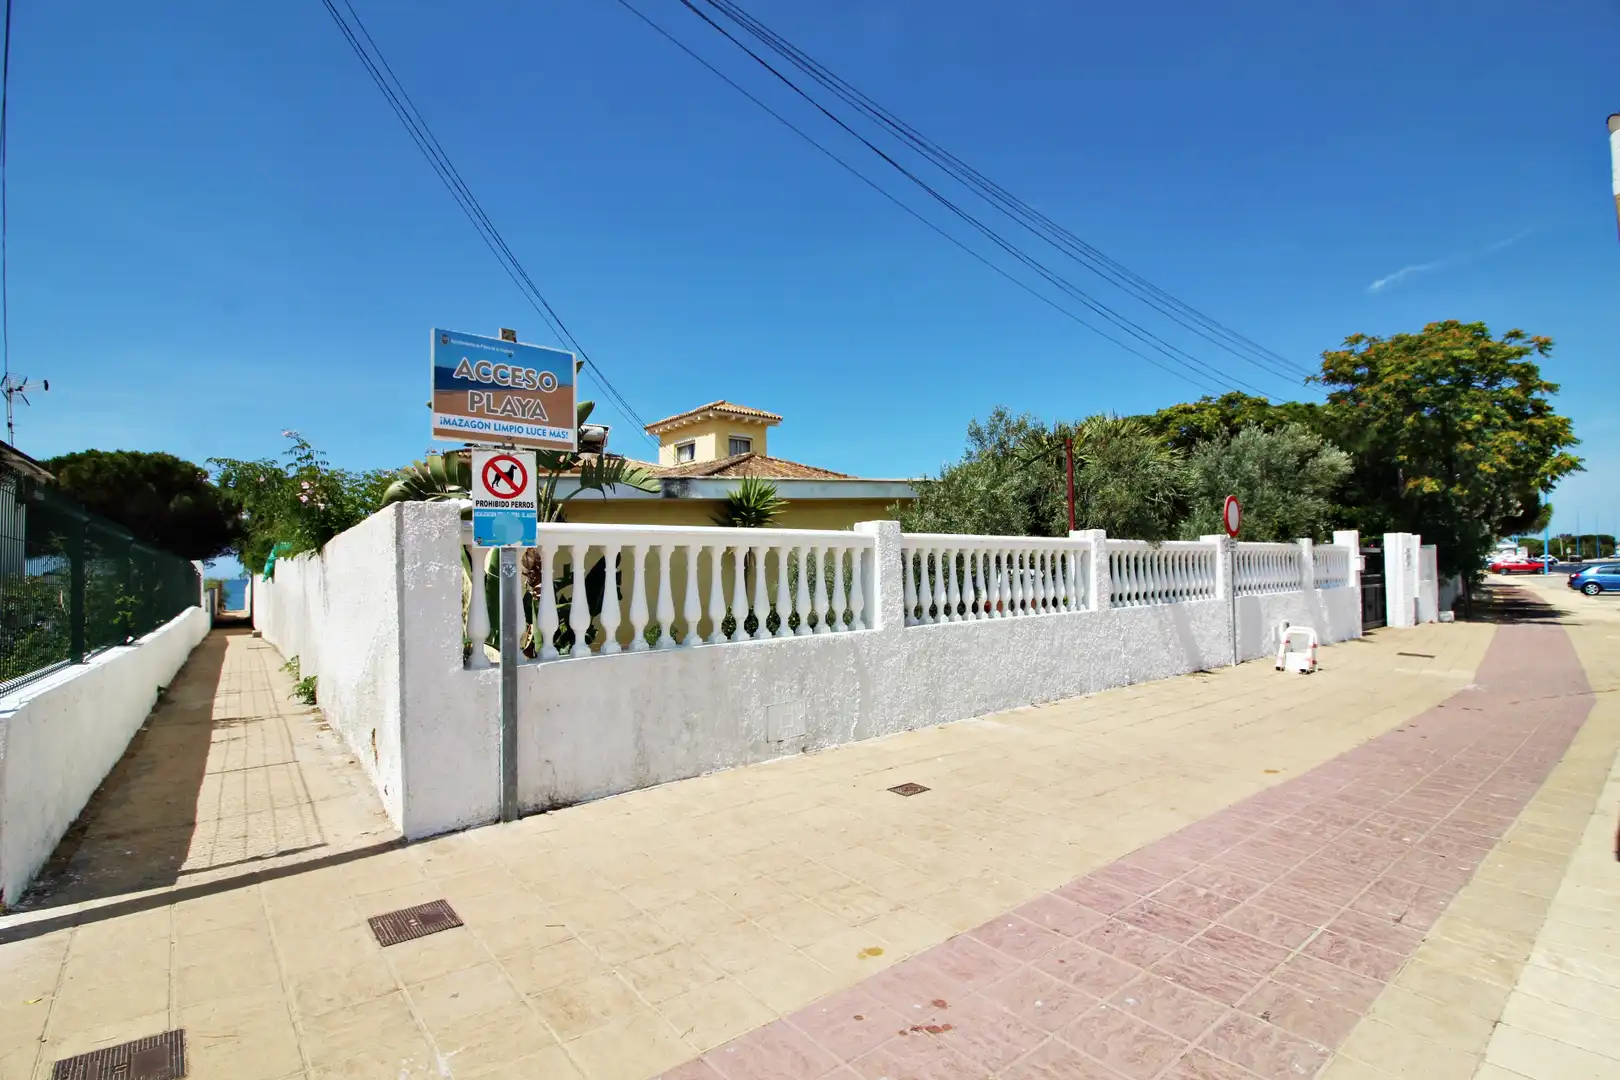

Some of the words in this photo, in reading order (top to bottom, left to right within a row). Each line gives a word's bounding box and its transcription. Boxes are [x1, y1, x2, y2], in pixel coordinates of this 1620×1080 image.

[453, 357, 558, 393] ACCESO
[468, 390, 549, 421] PLAYA
[494, 423, 524, 434] LIMPIO
[526, 427, 547, 437] LUCE
[475, 500, 510, 508] PROHIBIDO
